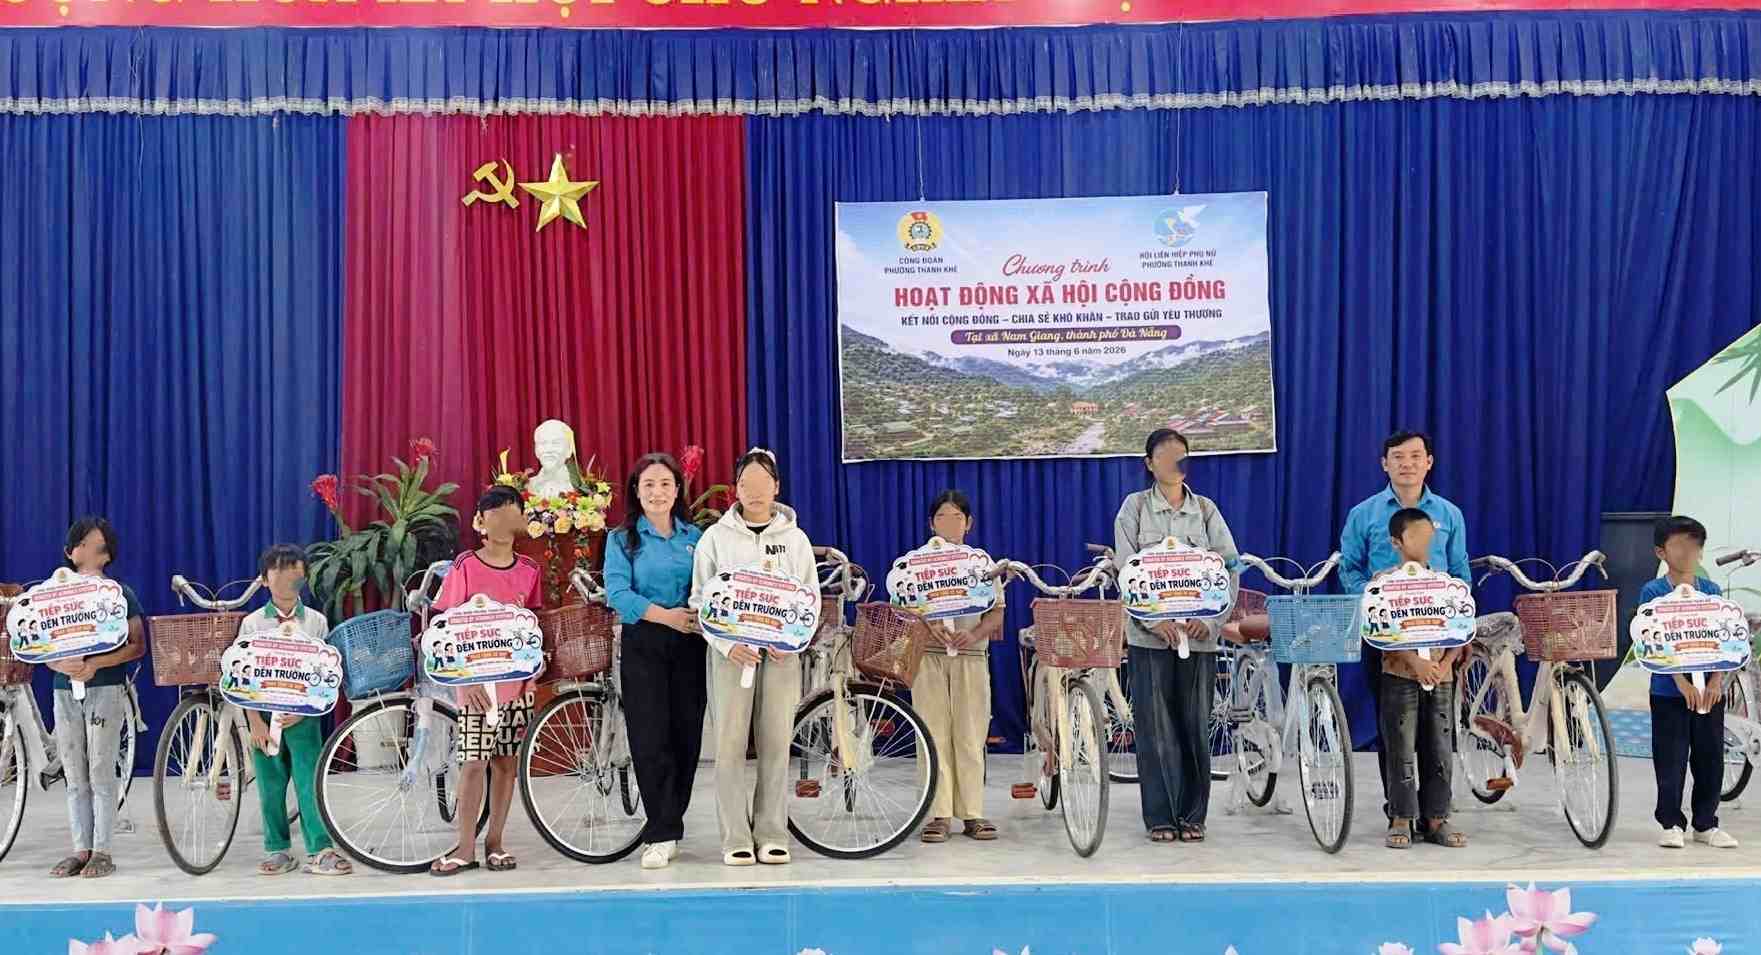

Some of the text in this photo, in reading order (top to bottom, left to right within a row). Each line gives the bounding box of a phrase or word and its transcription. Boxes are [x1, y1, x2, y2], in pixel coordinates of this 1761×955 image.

[1002, 254, 1112, 281] Chương trình
[895, 274, 1225, 310] HOẠT ĐỘNG XÃ HỘI CỘNG ĐỒNG
[1008, 348, 1030, 358] Ngày
[1046, 347, 1072, 358] tháng
[1104, 346, 1126, 354] 2026
